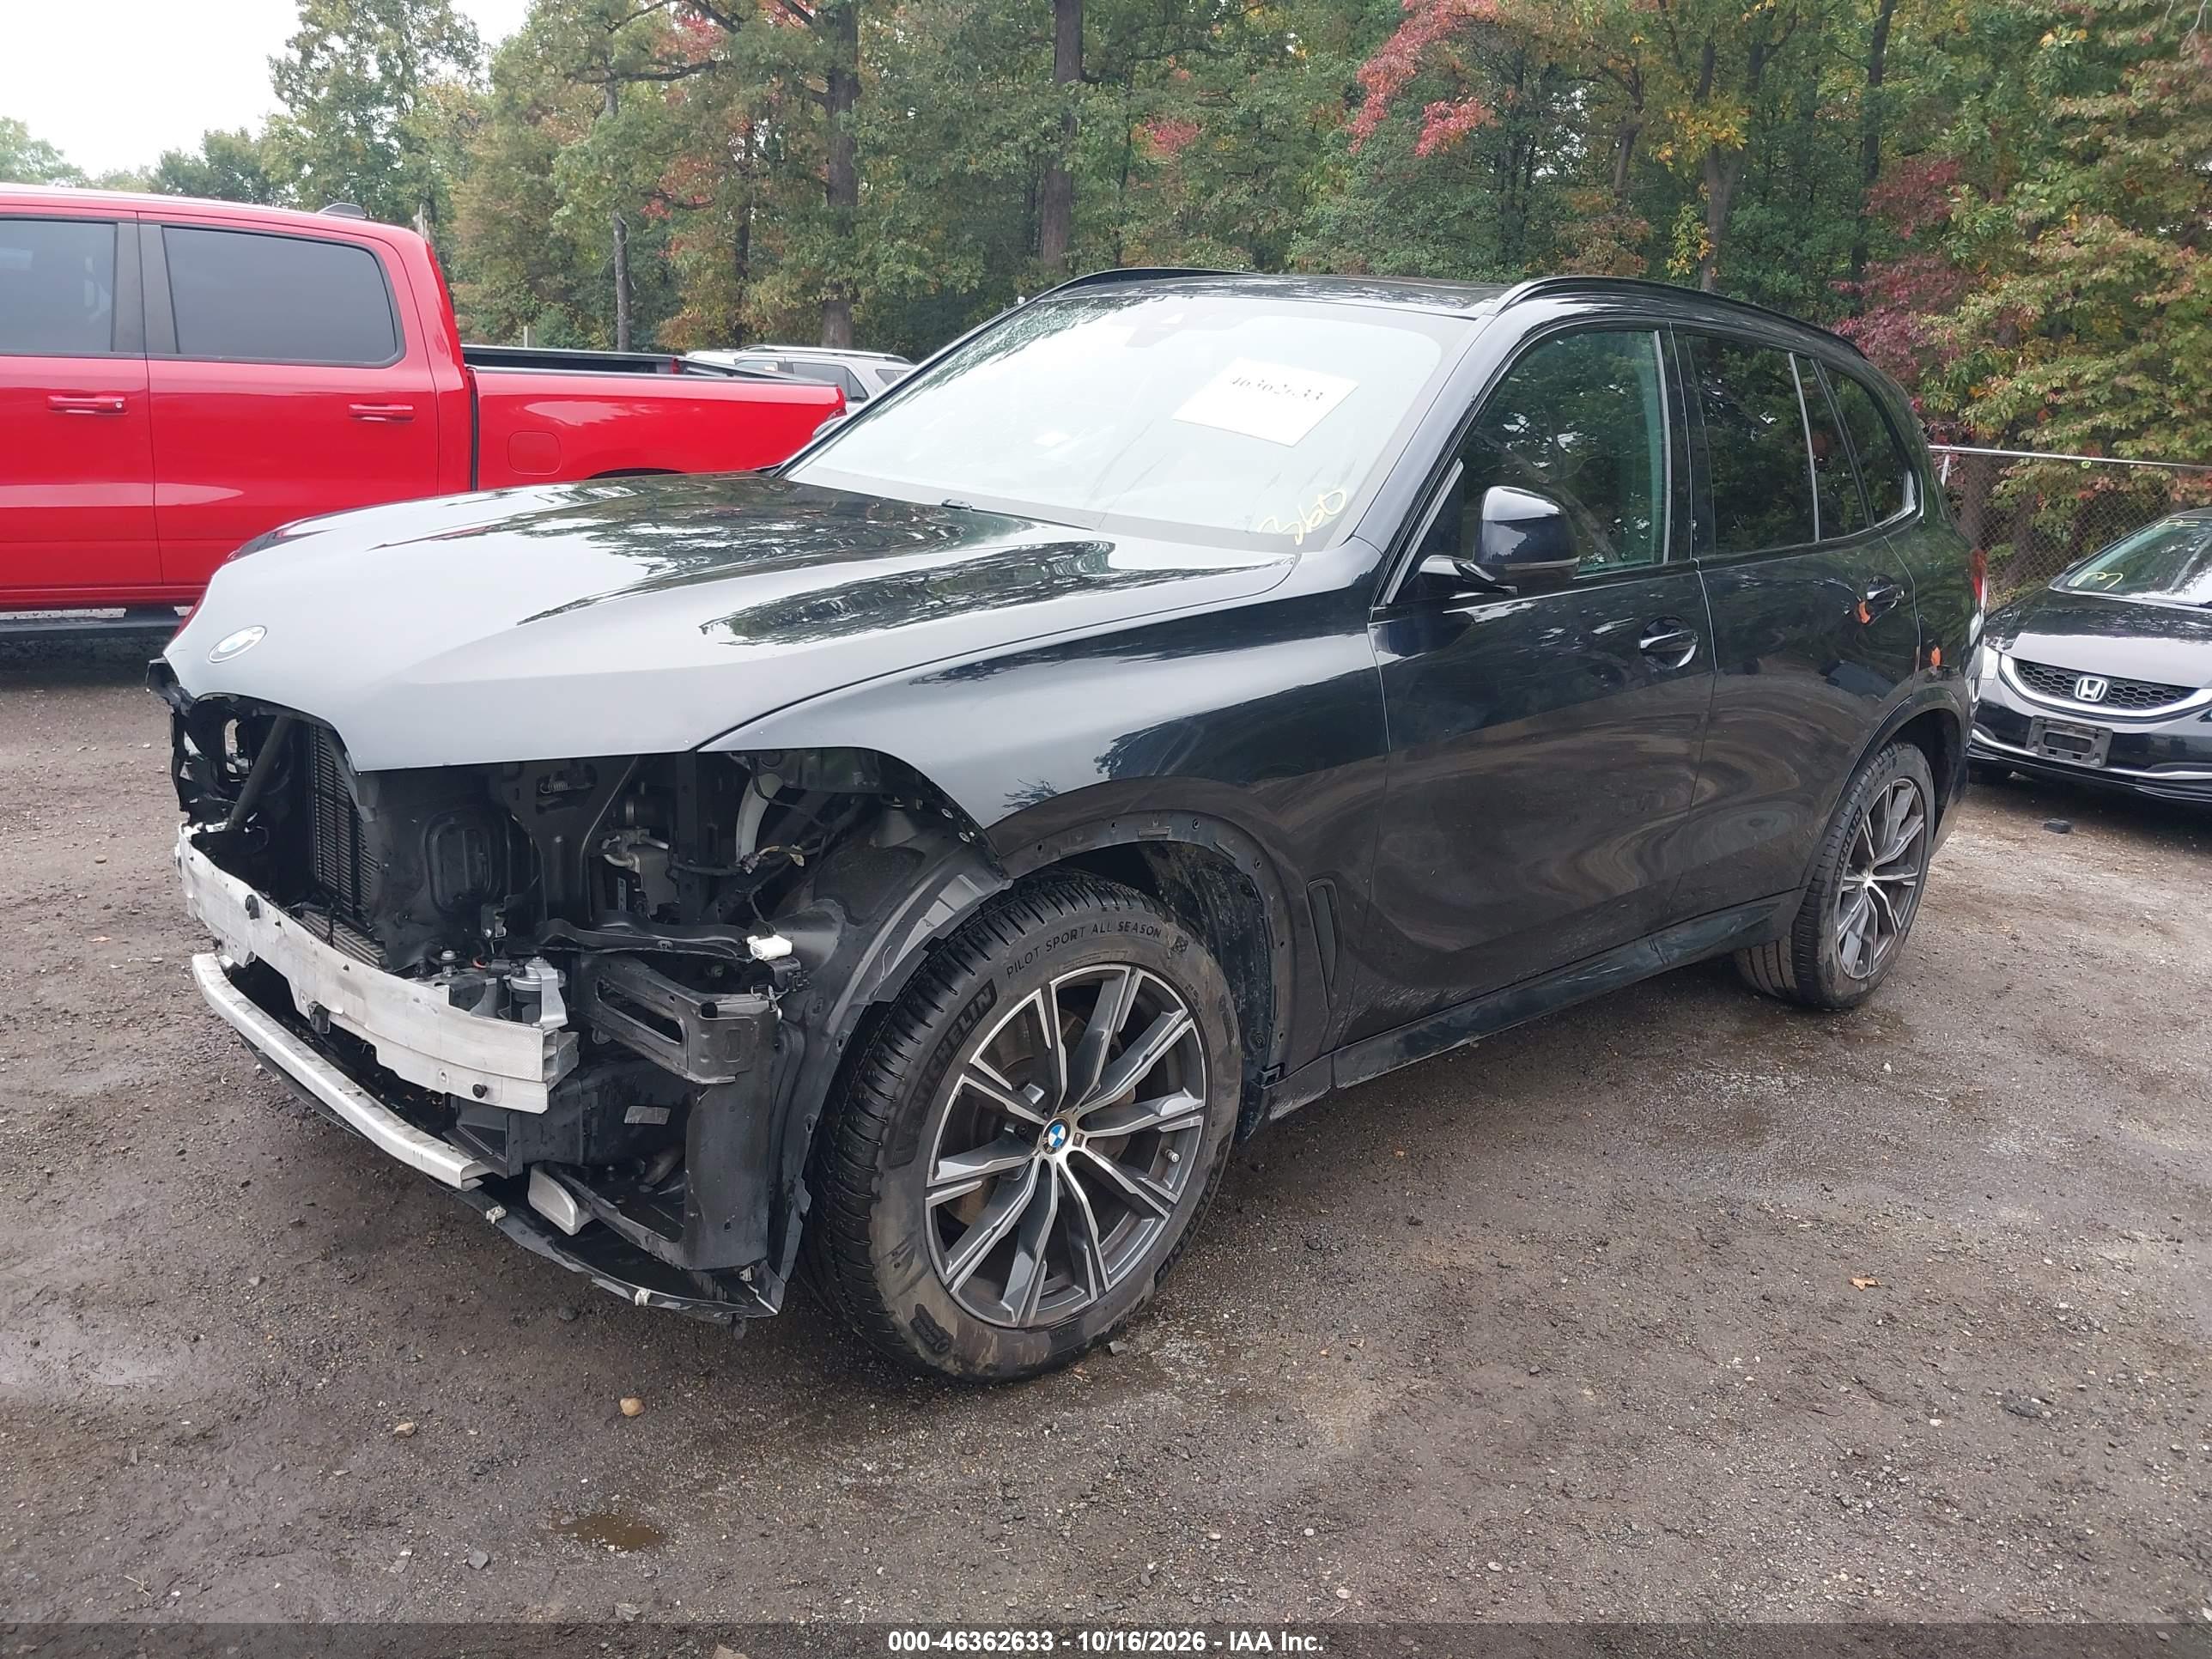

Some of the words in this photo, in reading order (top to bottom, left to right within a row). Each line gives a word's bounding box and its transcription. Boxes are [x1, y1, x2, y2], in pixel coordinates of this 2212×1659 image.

[1006, 946, 1040, 978] PILOT
[1045, 927, 1085, 952] SPORT
[1091, 923, 1113, 934] ALL
[1117, 921, 1162, 938] SEASON
